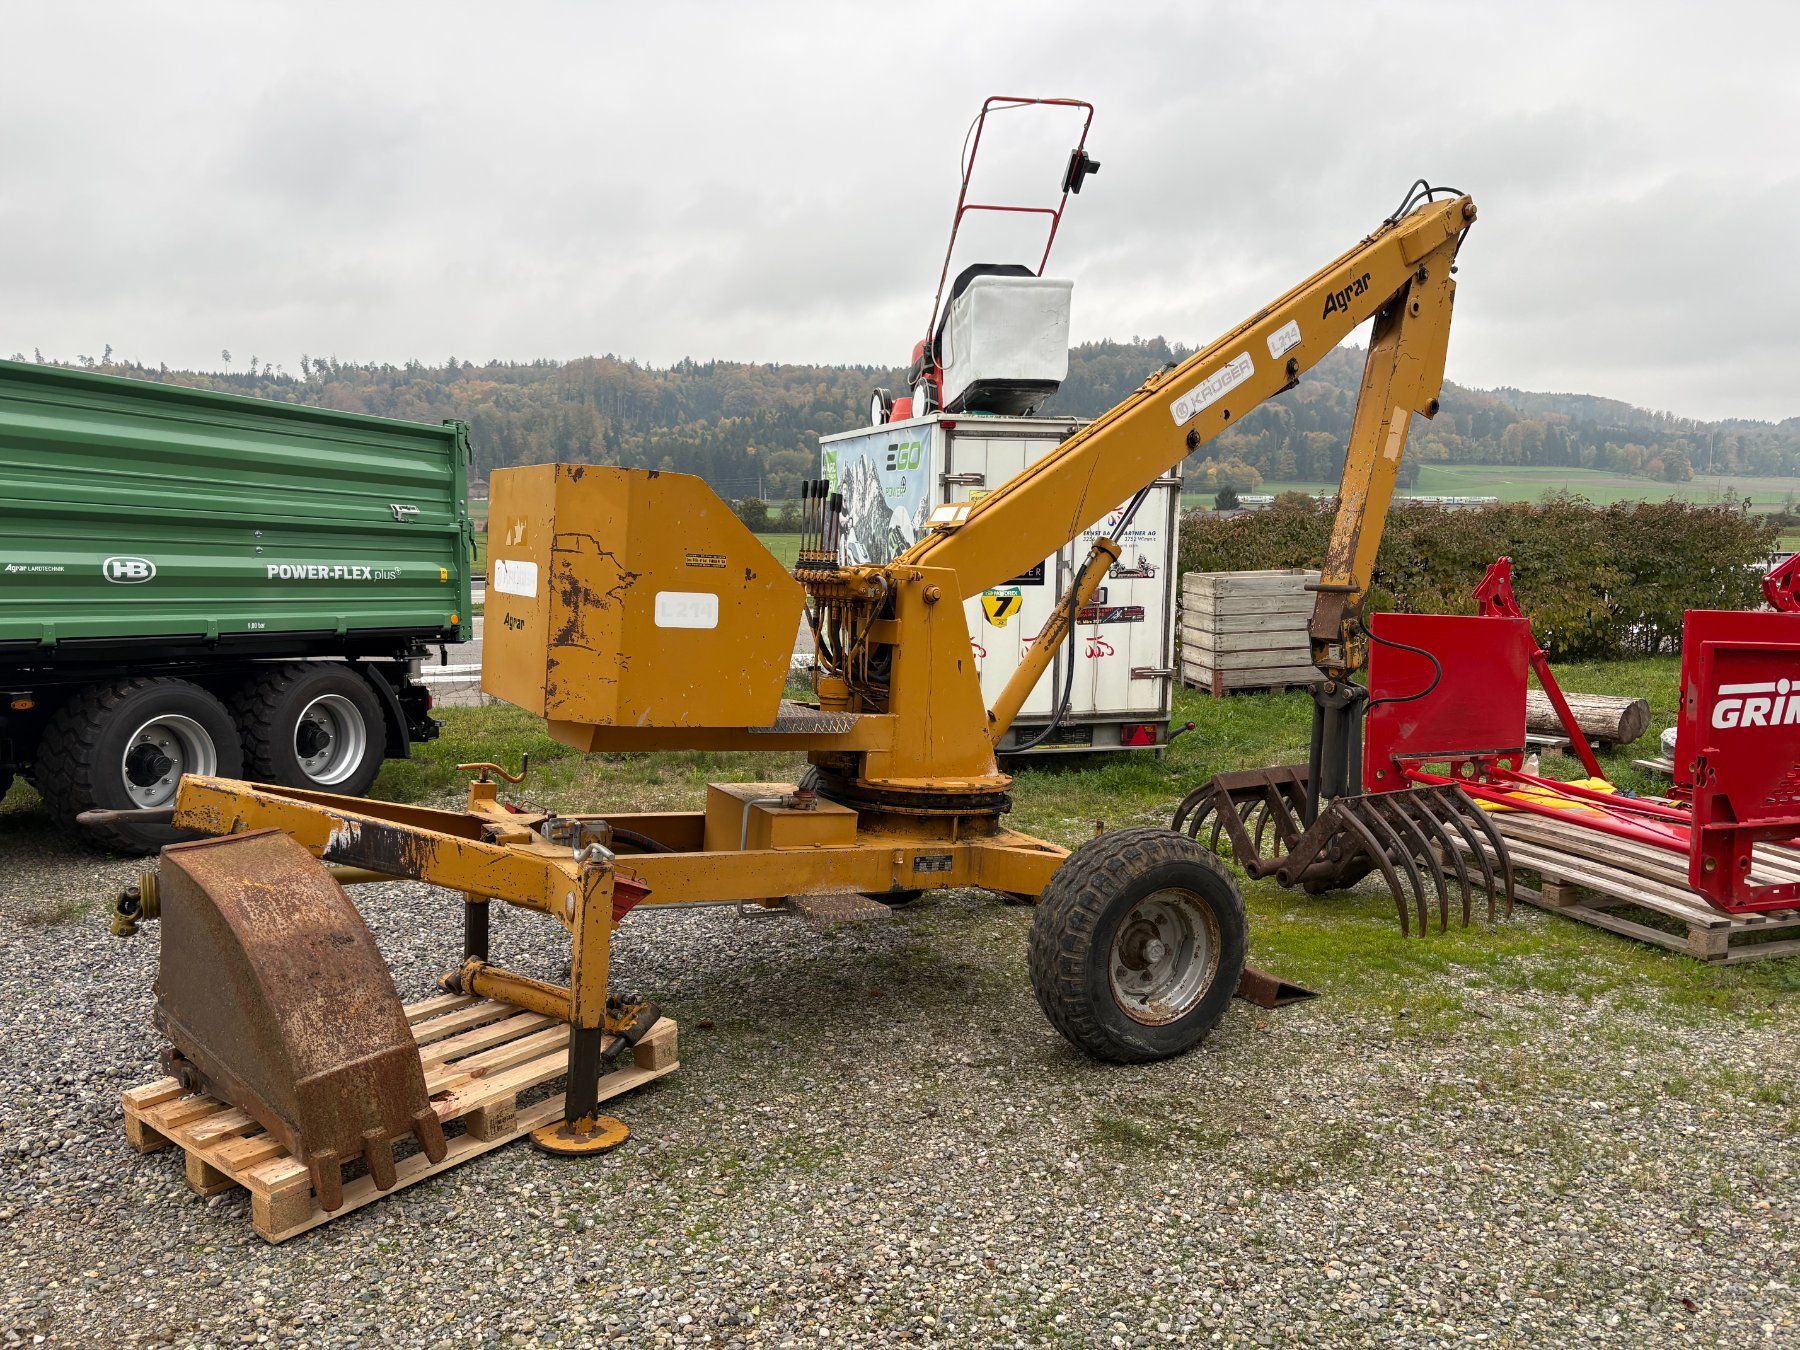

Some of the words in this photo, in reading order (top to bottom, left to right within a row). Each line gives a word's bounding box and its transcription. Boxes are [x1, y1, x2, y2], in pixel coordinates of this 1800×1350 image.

[1322, 272, 1371, 320] Agrar
[886, 441, 921, 471] EGO
[5, 563, 27, 573] Agrar
[112, 561, 149, 578] HB
[266, 564, 372, 580] POWER-FLEX
[993, 597, 1013, 617] 7
[503, 612, 525, 630] Agrar
